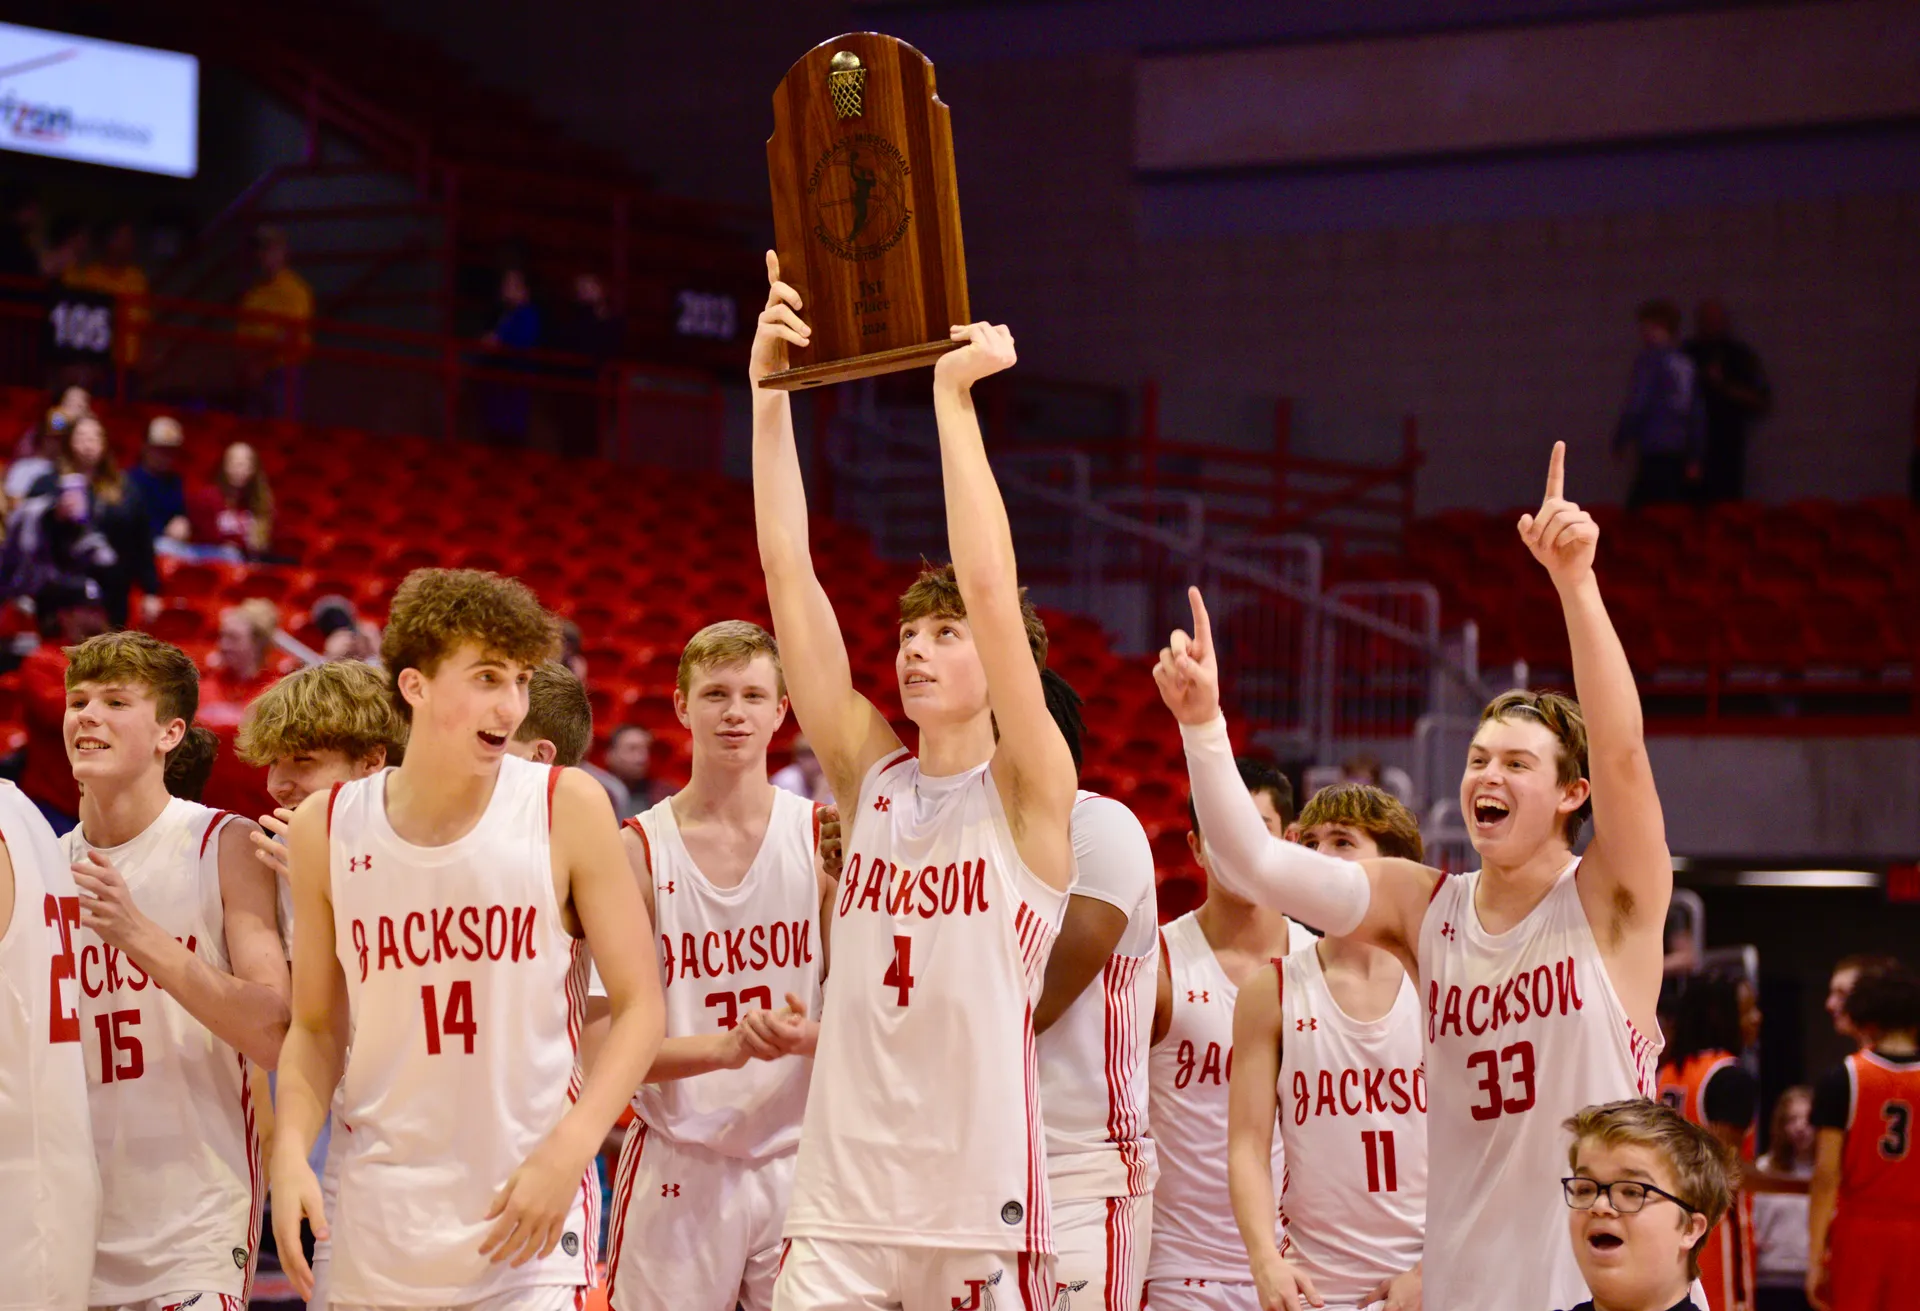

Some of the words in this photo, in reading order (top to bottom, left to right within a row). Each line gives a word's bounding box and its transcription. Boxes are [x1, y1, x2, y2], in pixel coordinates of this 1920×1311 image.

[808, 136, 851, 195] SOUTHEAST
[855, 133, 912, 176] MISSOURIAN
[814, 225, 863, 263] CHRISTMAS
[863, 208, 913, 262] TOURNAMENT
[854, 300, 890, 315] Place
[859, 279, 883, 297] 1st
[840, 853, 989, 919] JACKSON
[352, 905, 537, 983] JACKSON
[661, 919, 813, 988] JACKSON
[883, 935, 914, 1007] 4
[421, 981, 477, 1055] 14
[1428, 956, 1583, 1044] JACKSON
[94, 1009, 144, 1084] 15
[1466, 1041, 1535, 1121] 33
[1361, 1130, 1397, 1192] 11
[1879, 1103, 1911, 1156] 3
